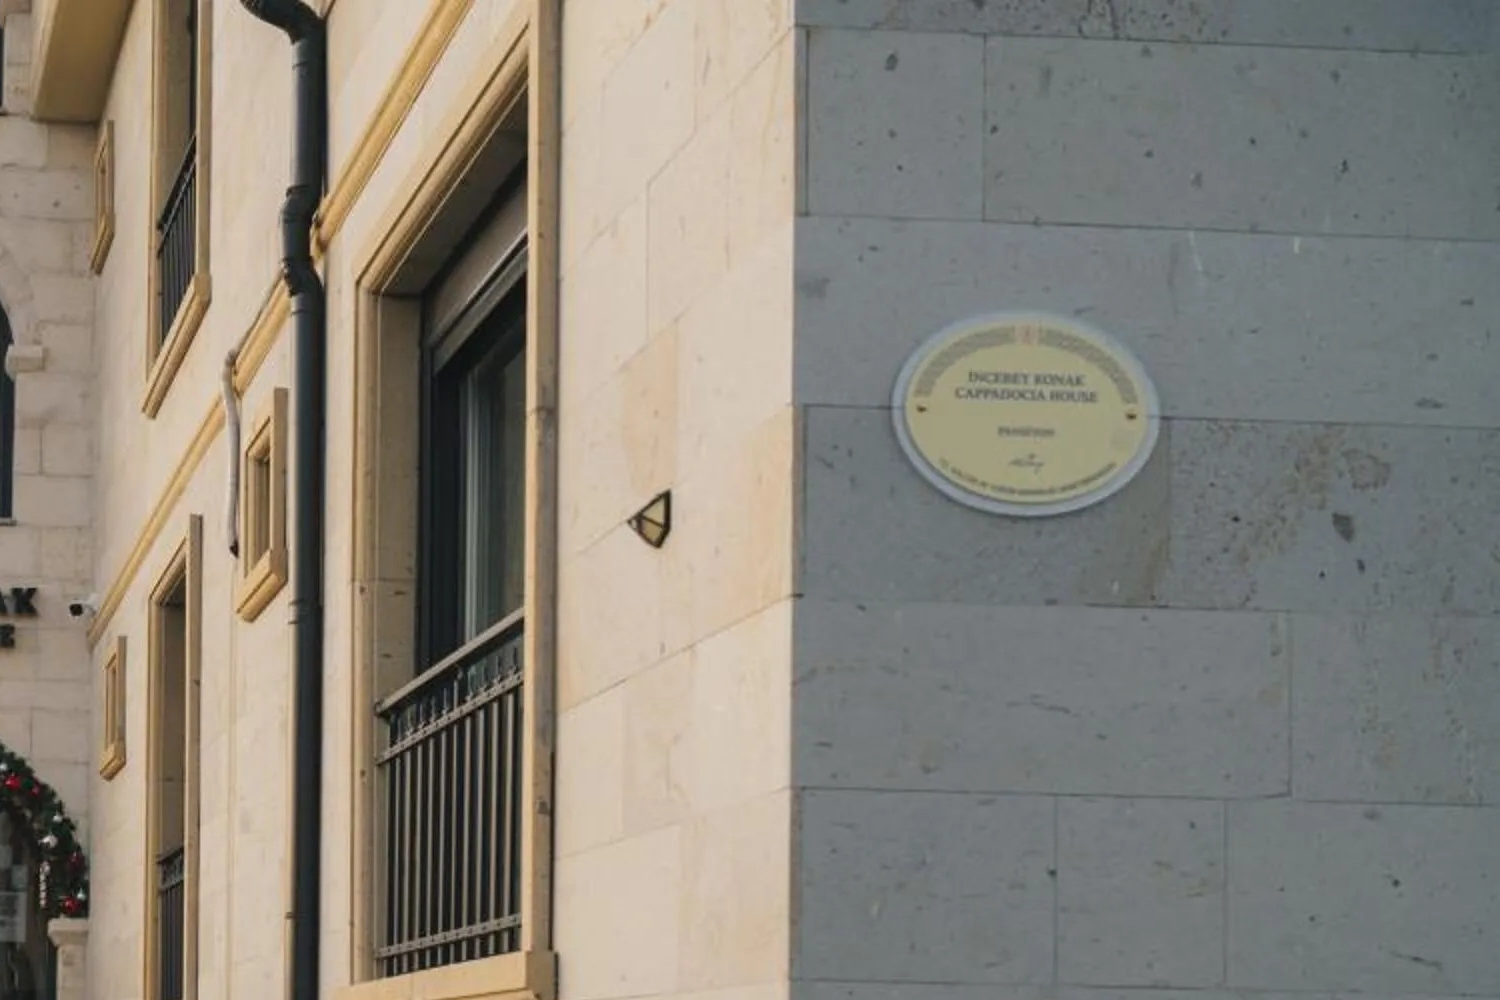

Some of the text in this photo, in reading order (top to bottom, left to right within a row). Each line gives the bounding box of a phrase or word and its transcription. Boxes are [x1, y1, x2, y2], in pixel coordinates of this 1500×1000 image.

[1035, 373, 1086, 386] KONAK
[955, 386, 1099, 403] CAPPADOCIA HOUSE
